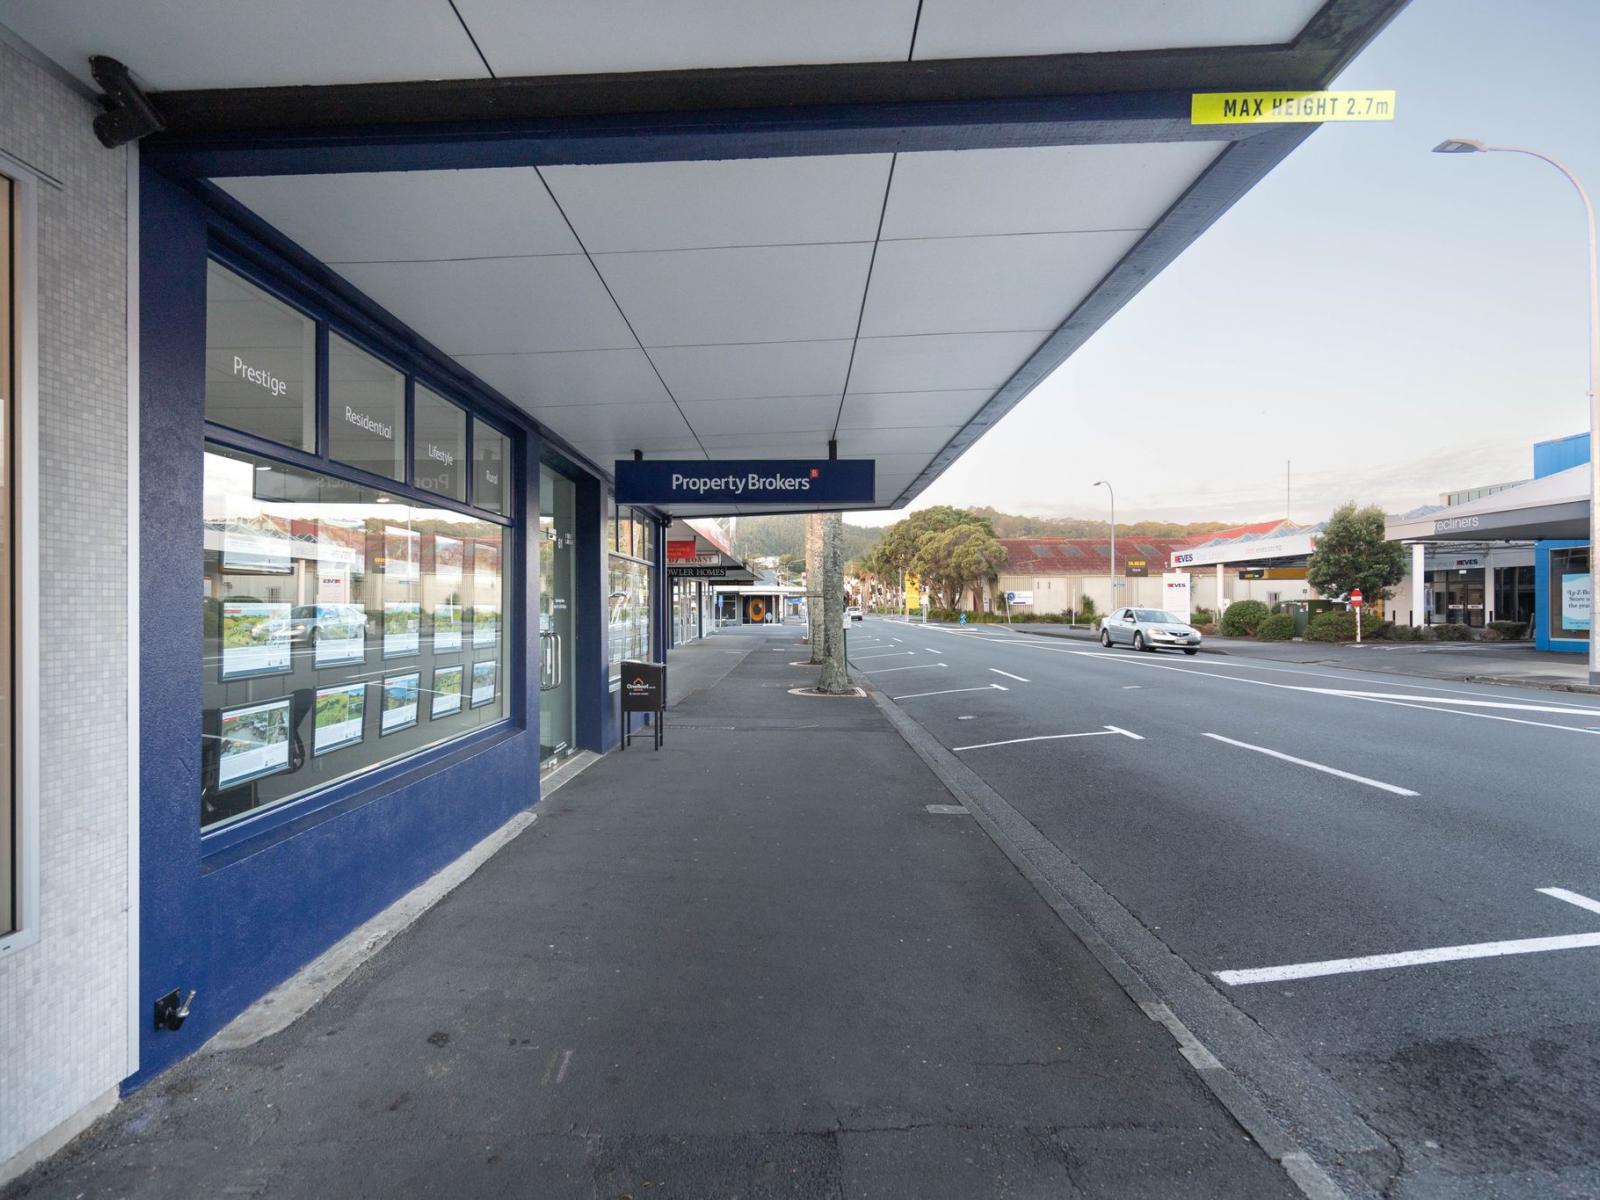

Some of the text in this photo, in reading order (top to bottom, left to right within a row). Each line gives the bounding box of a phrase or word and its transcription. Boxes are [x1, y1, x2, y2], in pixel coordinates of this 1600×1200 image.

[1223, 97, 1389, 117] MAX HEIGHT 2.7m
[232, 355, 287, 396] Prestige
[345, 405, 392, 440] Residential
[428, 443, 454, 466] Lifestyle
[672, 473, 810, 494] Property Brokers
[1432, 516, 1479, 531] recliners
[696, 568, 724, 576] HOMES
